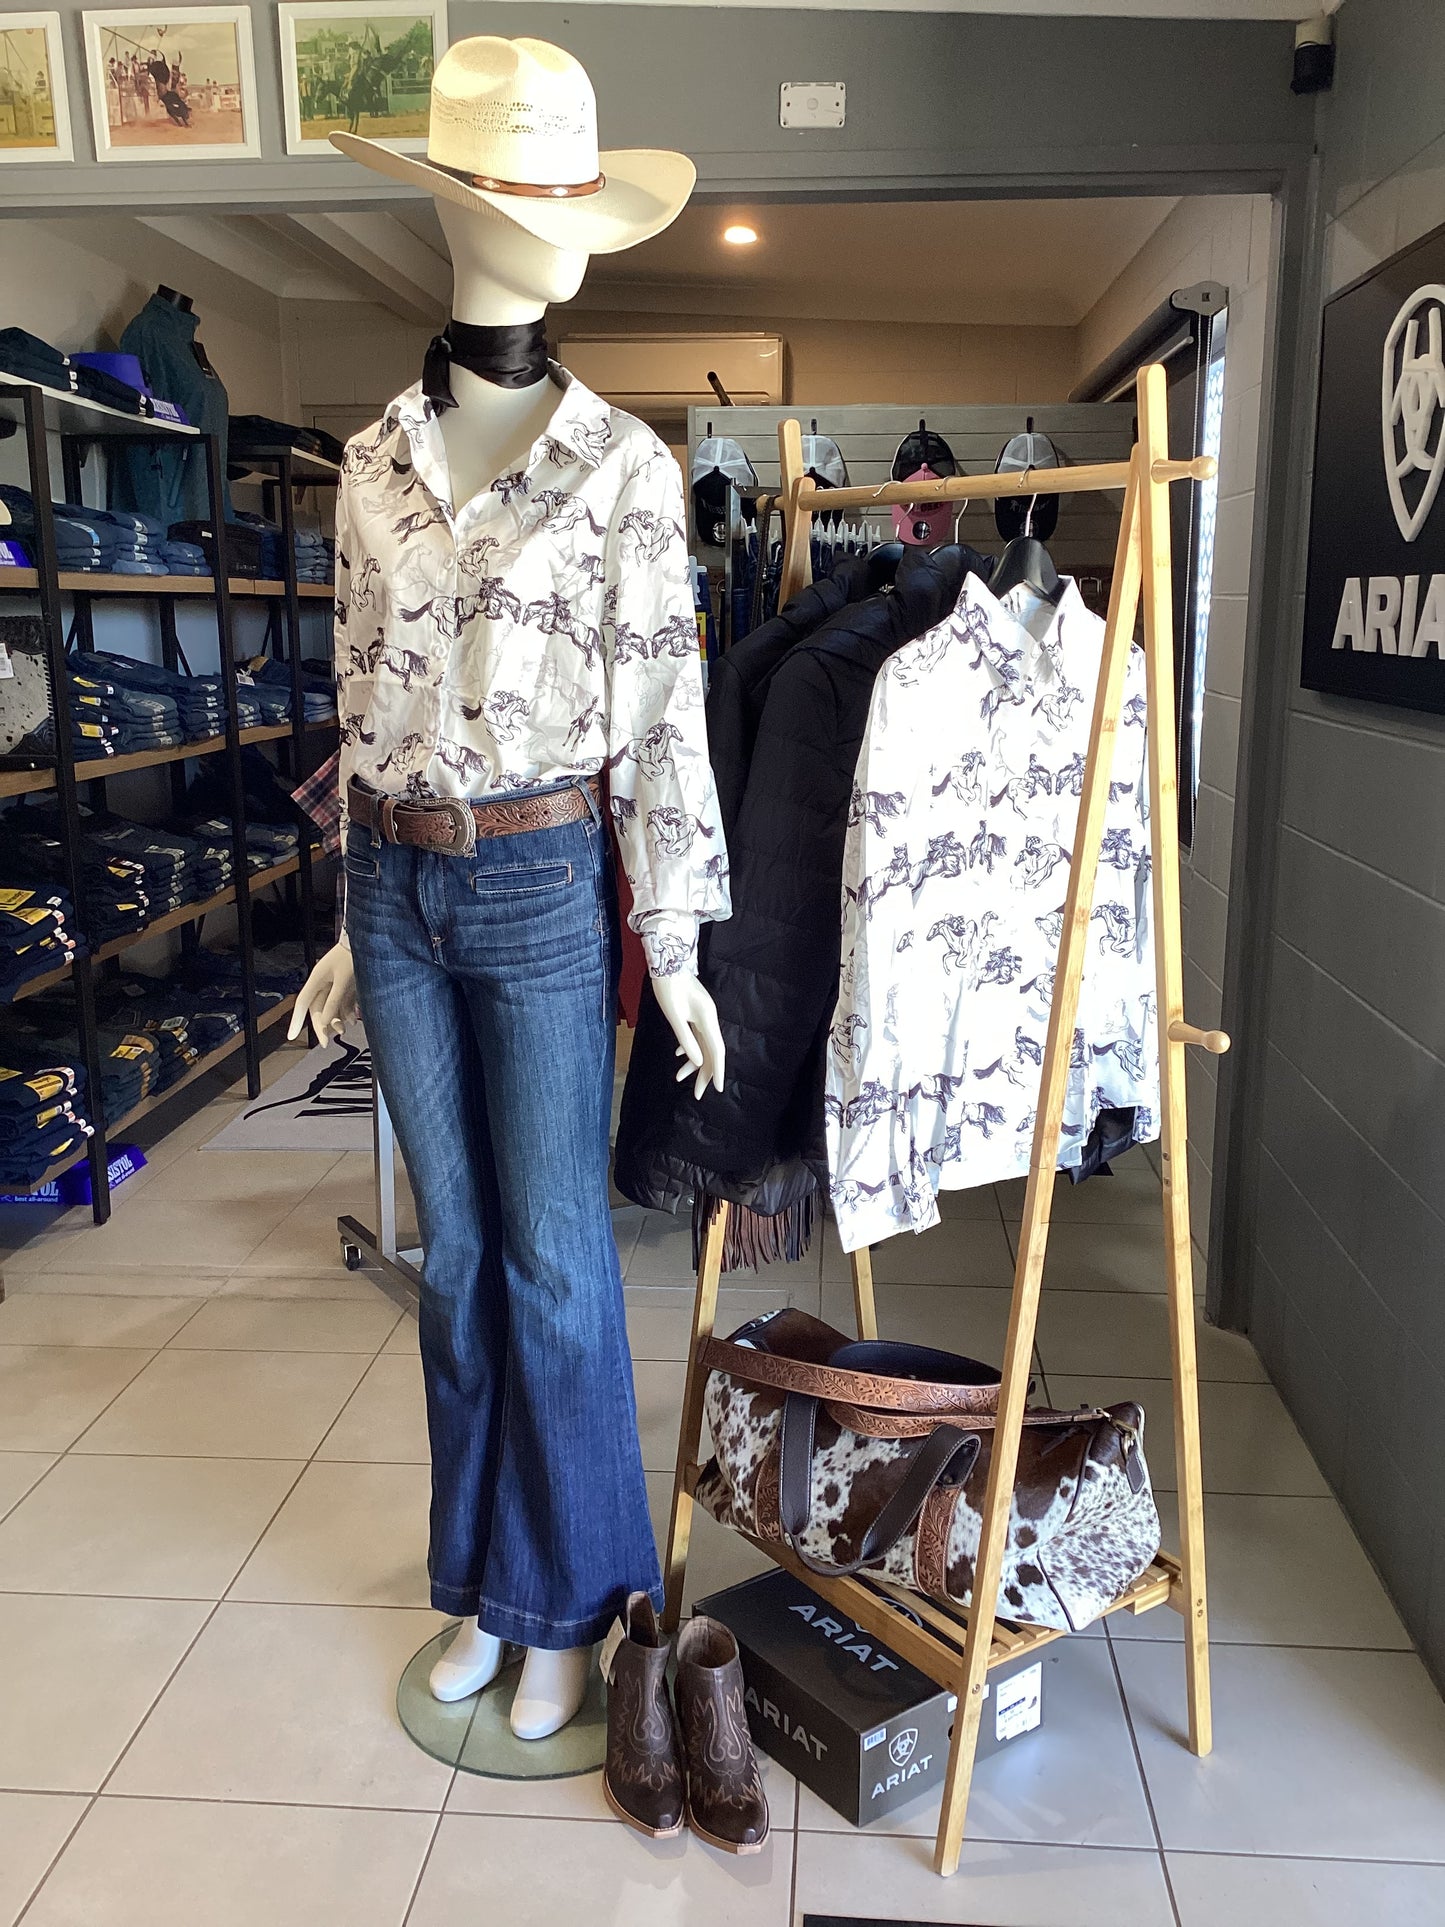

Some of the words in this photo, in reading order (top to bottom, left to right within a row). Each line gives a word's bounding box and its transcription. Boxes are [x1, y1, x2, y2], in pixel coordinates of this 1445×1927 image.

[1331, 573, 1445, 660] ARIA
[32, 1181, 59, 1196] OL
[788, 1605, 899, 1671] ARIAT
[745, 1686, 828, 1761] ARIAT
[871, 1754, 933, 1800] ARIAT
